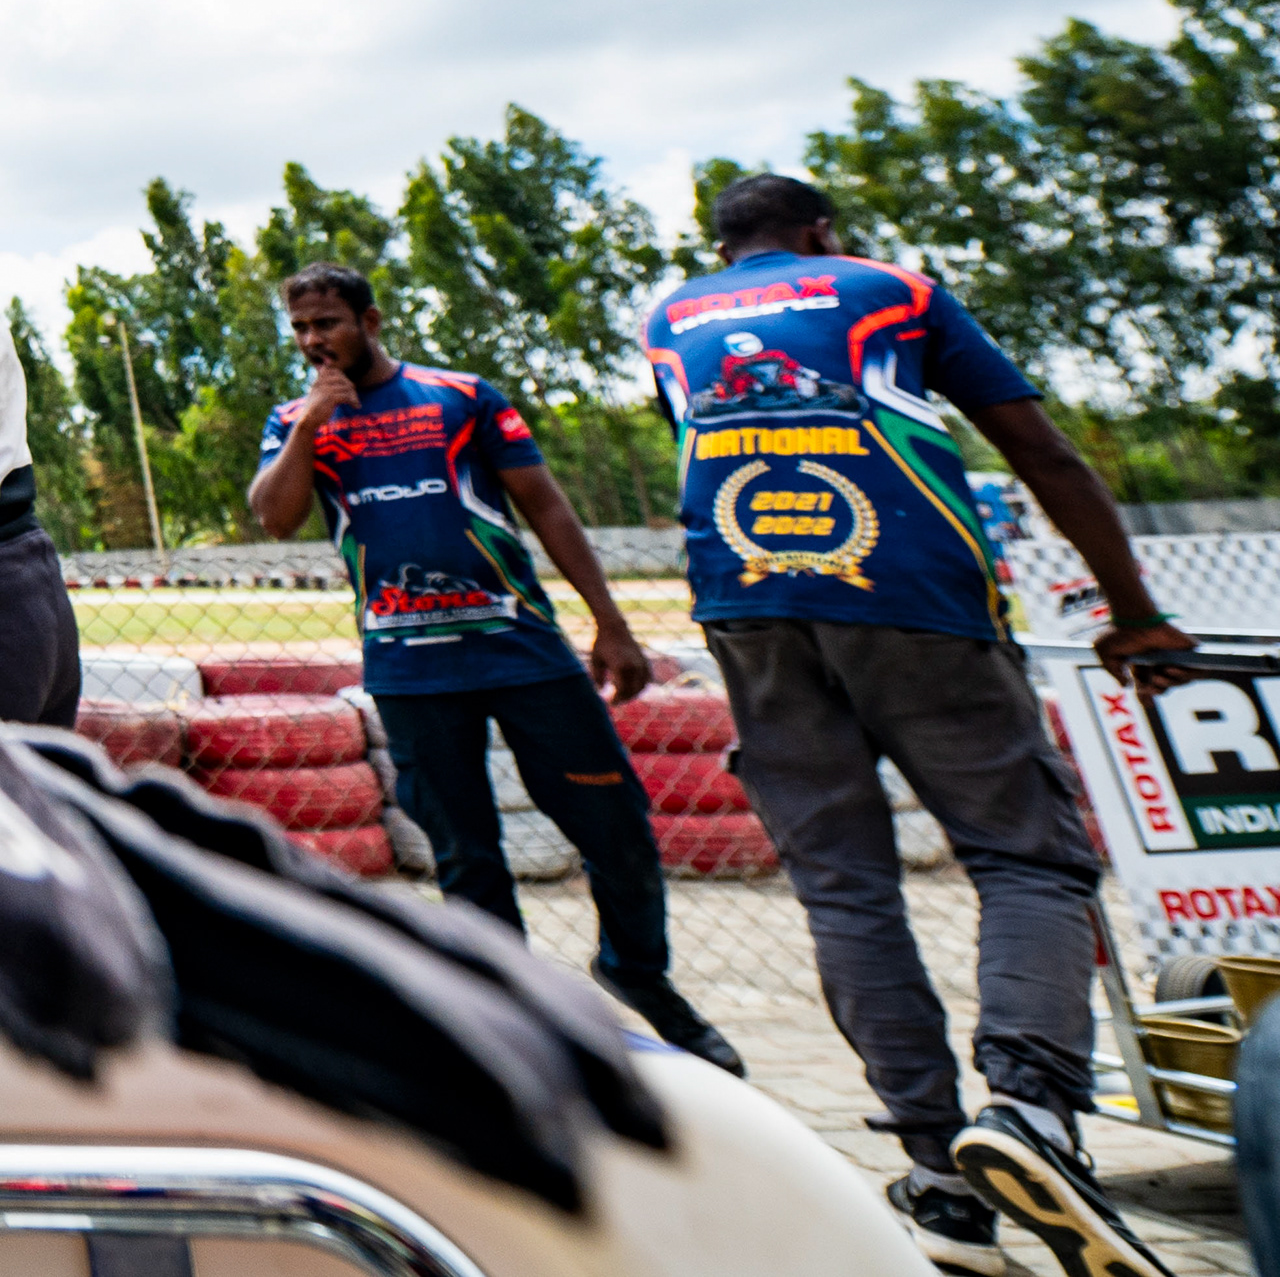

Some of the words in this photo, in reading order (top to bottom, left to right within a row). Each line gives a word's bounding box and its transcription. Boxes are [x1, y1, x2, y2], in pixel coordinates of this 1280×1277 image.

[666, 275, 838, 324] ROTAX
[696, 426, 870, 460] NATIONAL
[750, 491, 834, 512] 2021
[752, 516, 835, 536] 2022
[1100, 692, 1176, 834] ROTAX
[1196, 804, 1280, 835] INDI
